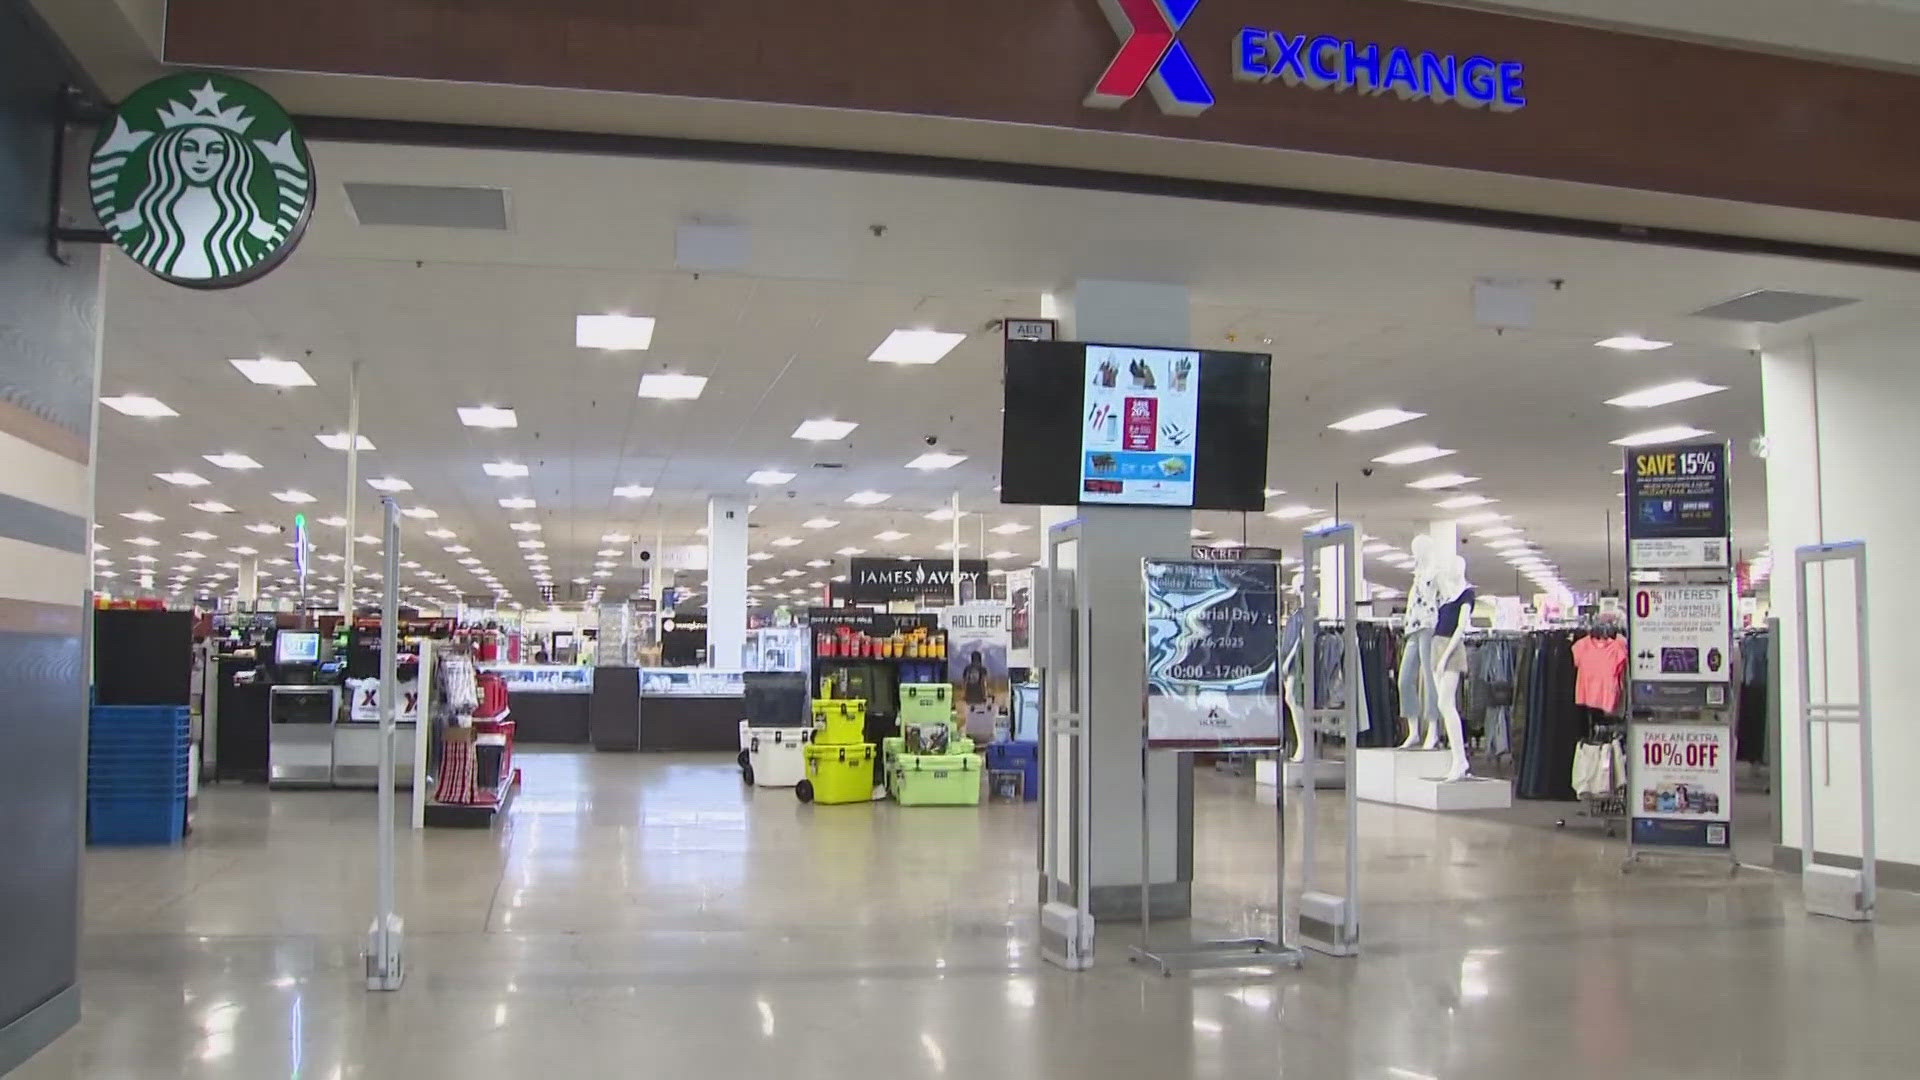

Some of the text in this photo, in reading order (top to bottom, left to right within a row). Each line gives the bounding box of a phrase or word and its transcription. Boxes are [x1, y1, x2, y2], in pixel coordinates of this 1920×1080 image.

[1238, 27, 1527, 107] EXCHANGE
[1017, 324, 1043, 335] AED
[1636, 452, 1715, 476] SAVE 15%
[860, 570, 912, 586] JAMES
[1636, 589, 1720, 618] 0% INTEREST
[952, 615, 1002, 629] ROLL DEEP
[1232, 608, 1258, 625] Day
[1218, 637, 1244, 649] 2025
[1166, 665, 1203, 678] 10:00
[1215, 665, 1252, 679] 17:00
[1643, 731, 1719, 742] TAKE AN EXTRA
[1643, 743, 1719, 767] 10% OFF
